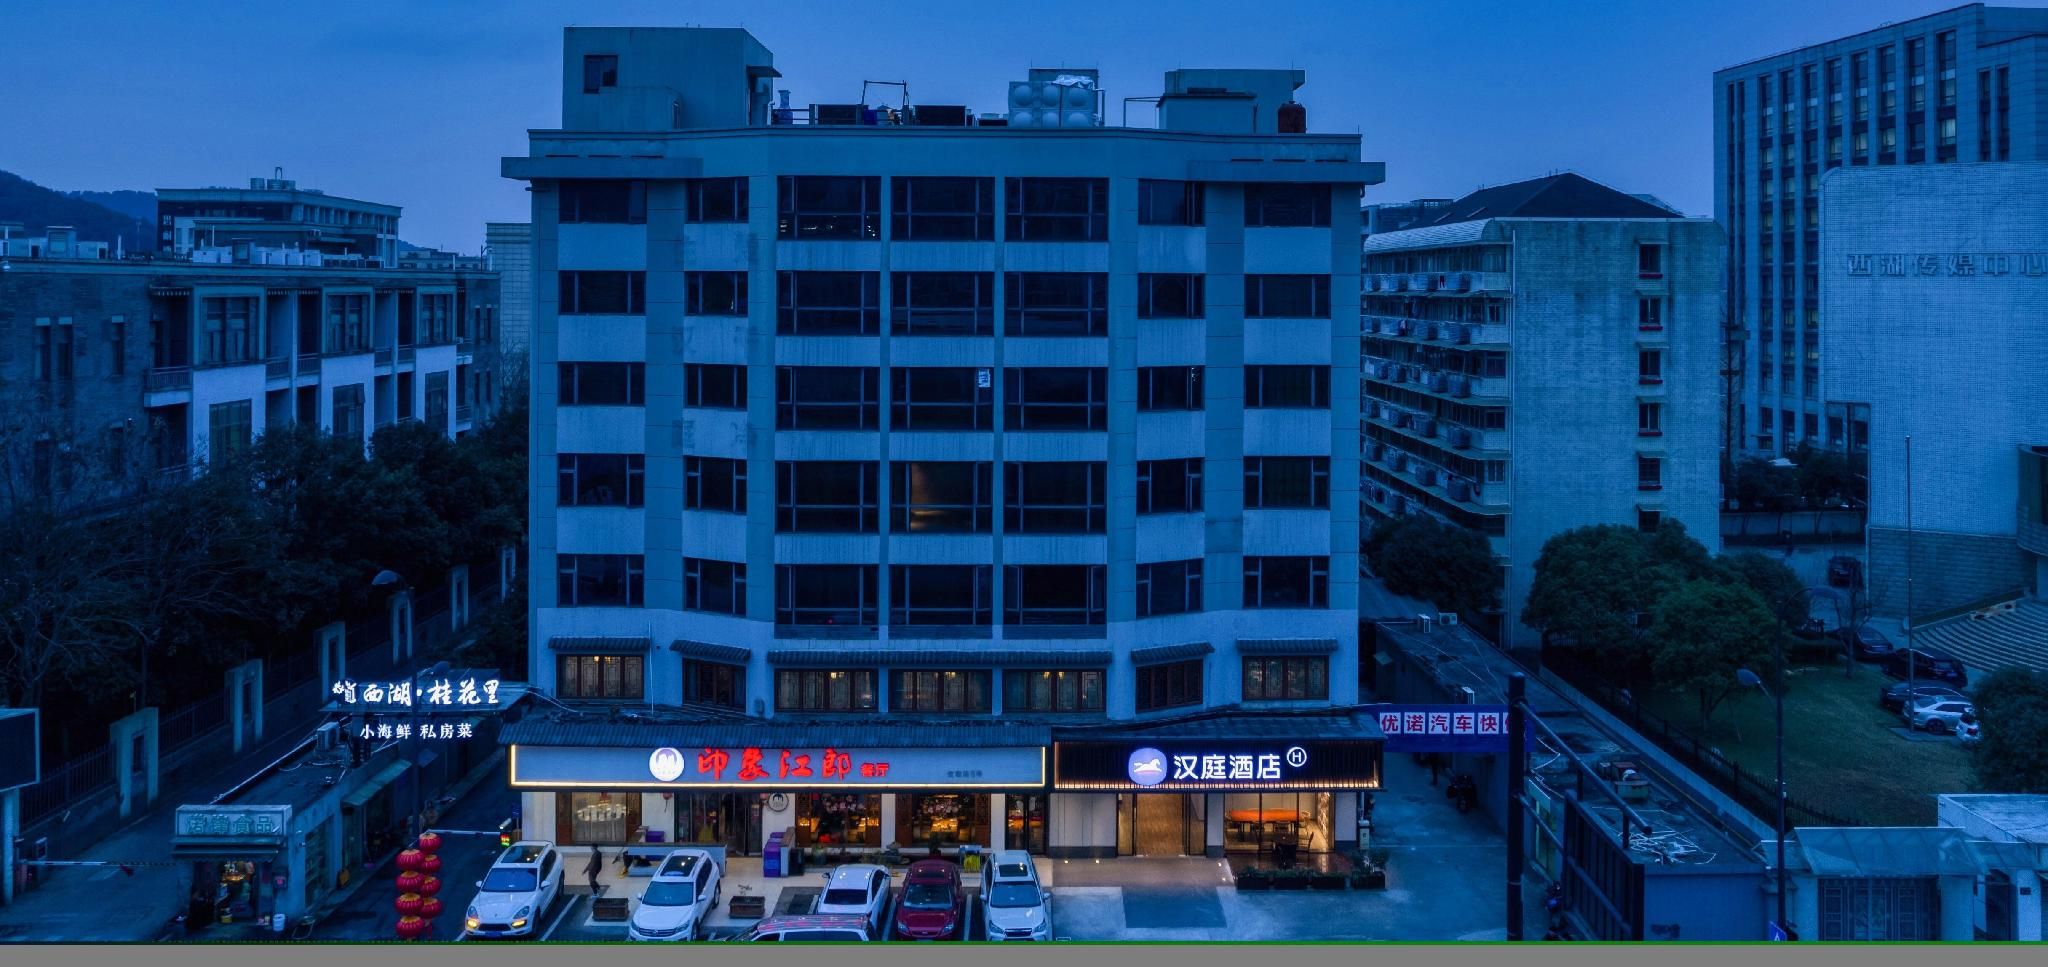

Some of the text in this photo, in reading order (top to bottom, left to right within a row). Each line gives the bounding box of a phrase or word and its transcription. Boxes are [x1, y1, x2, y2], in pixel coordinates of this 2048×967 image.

[1847, 254, 2047, 276] 西湖传媒中心
[360, 723, 473, 739] 小海鲜 私房菜
[1381, 714, 1509, 732] 优诺汽车快
[698, 747, 889, 780] 印象江郎 餐厅
[1173, 754, 1281, 779] 汉庭酒店
